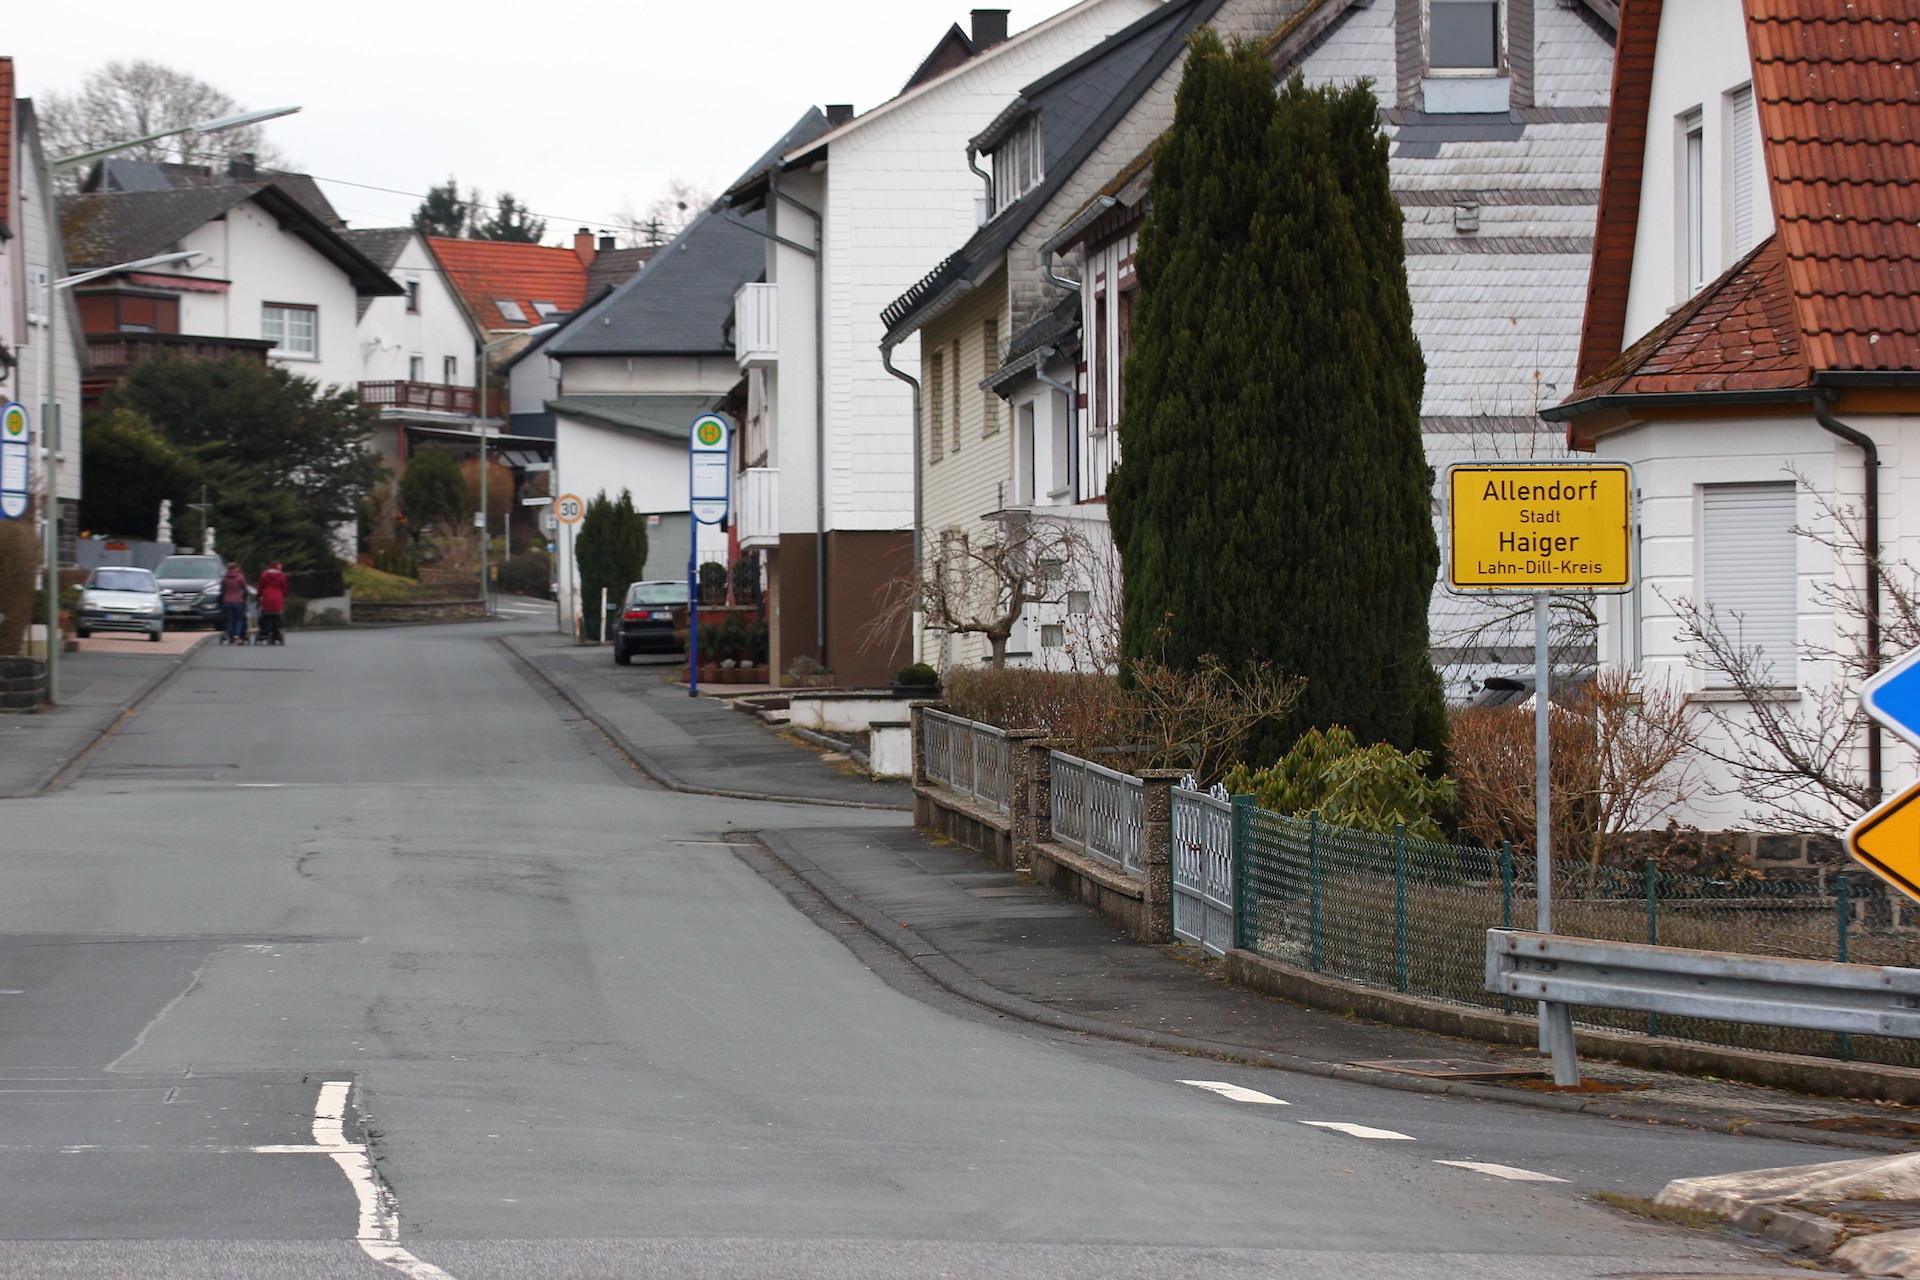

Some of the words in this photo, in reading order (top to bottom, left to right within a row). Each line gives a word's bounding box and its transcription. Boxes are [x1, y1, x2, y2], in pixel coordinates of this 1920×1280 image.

[703, 425, 716, 441] H
[1482, 480, 1598, 501] Allendorf
[560, 502, 579, 517] 30
[1519, 509, 1561, 524] Stadt
[1499, 531, 1580, 558] Haiger
[1478, 560, 1603, 575] Lahn-Dill-Kreis
